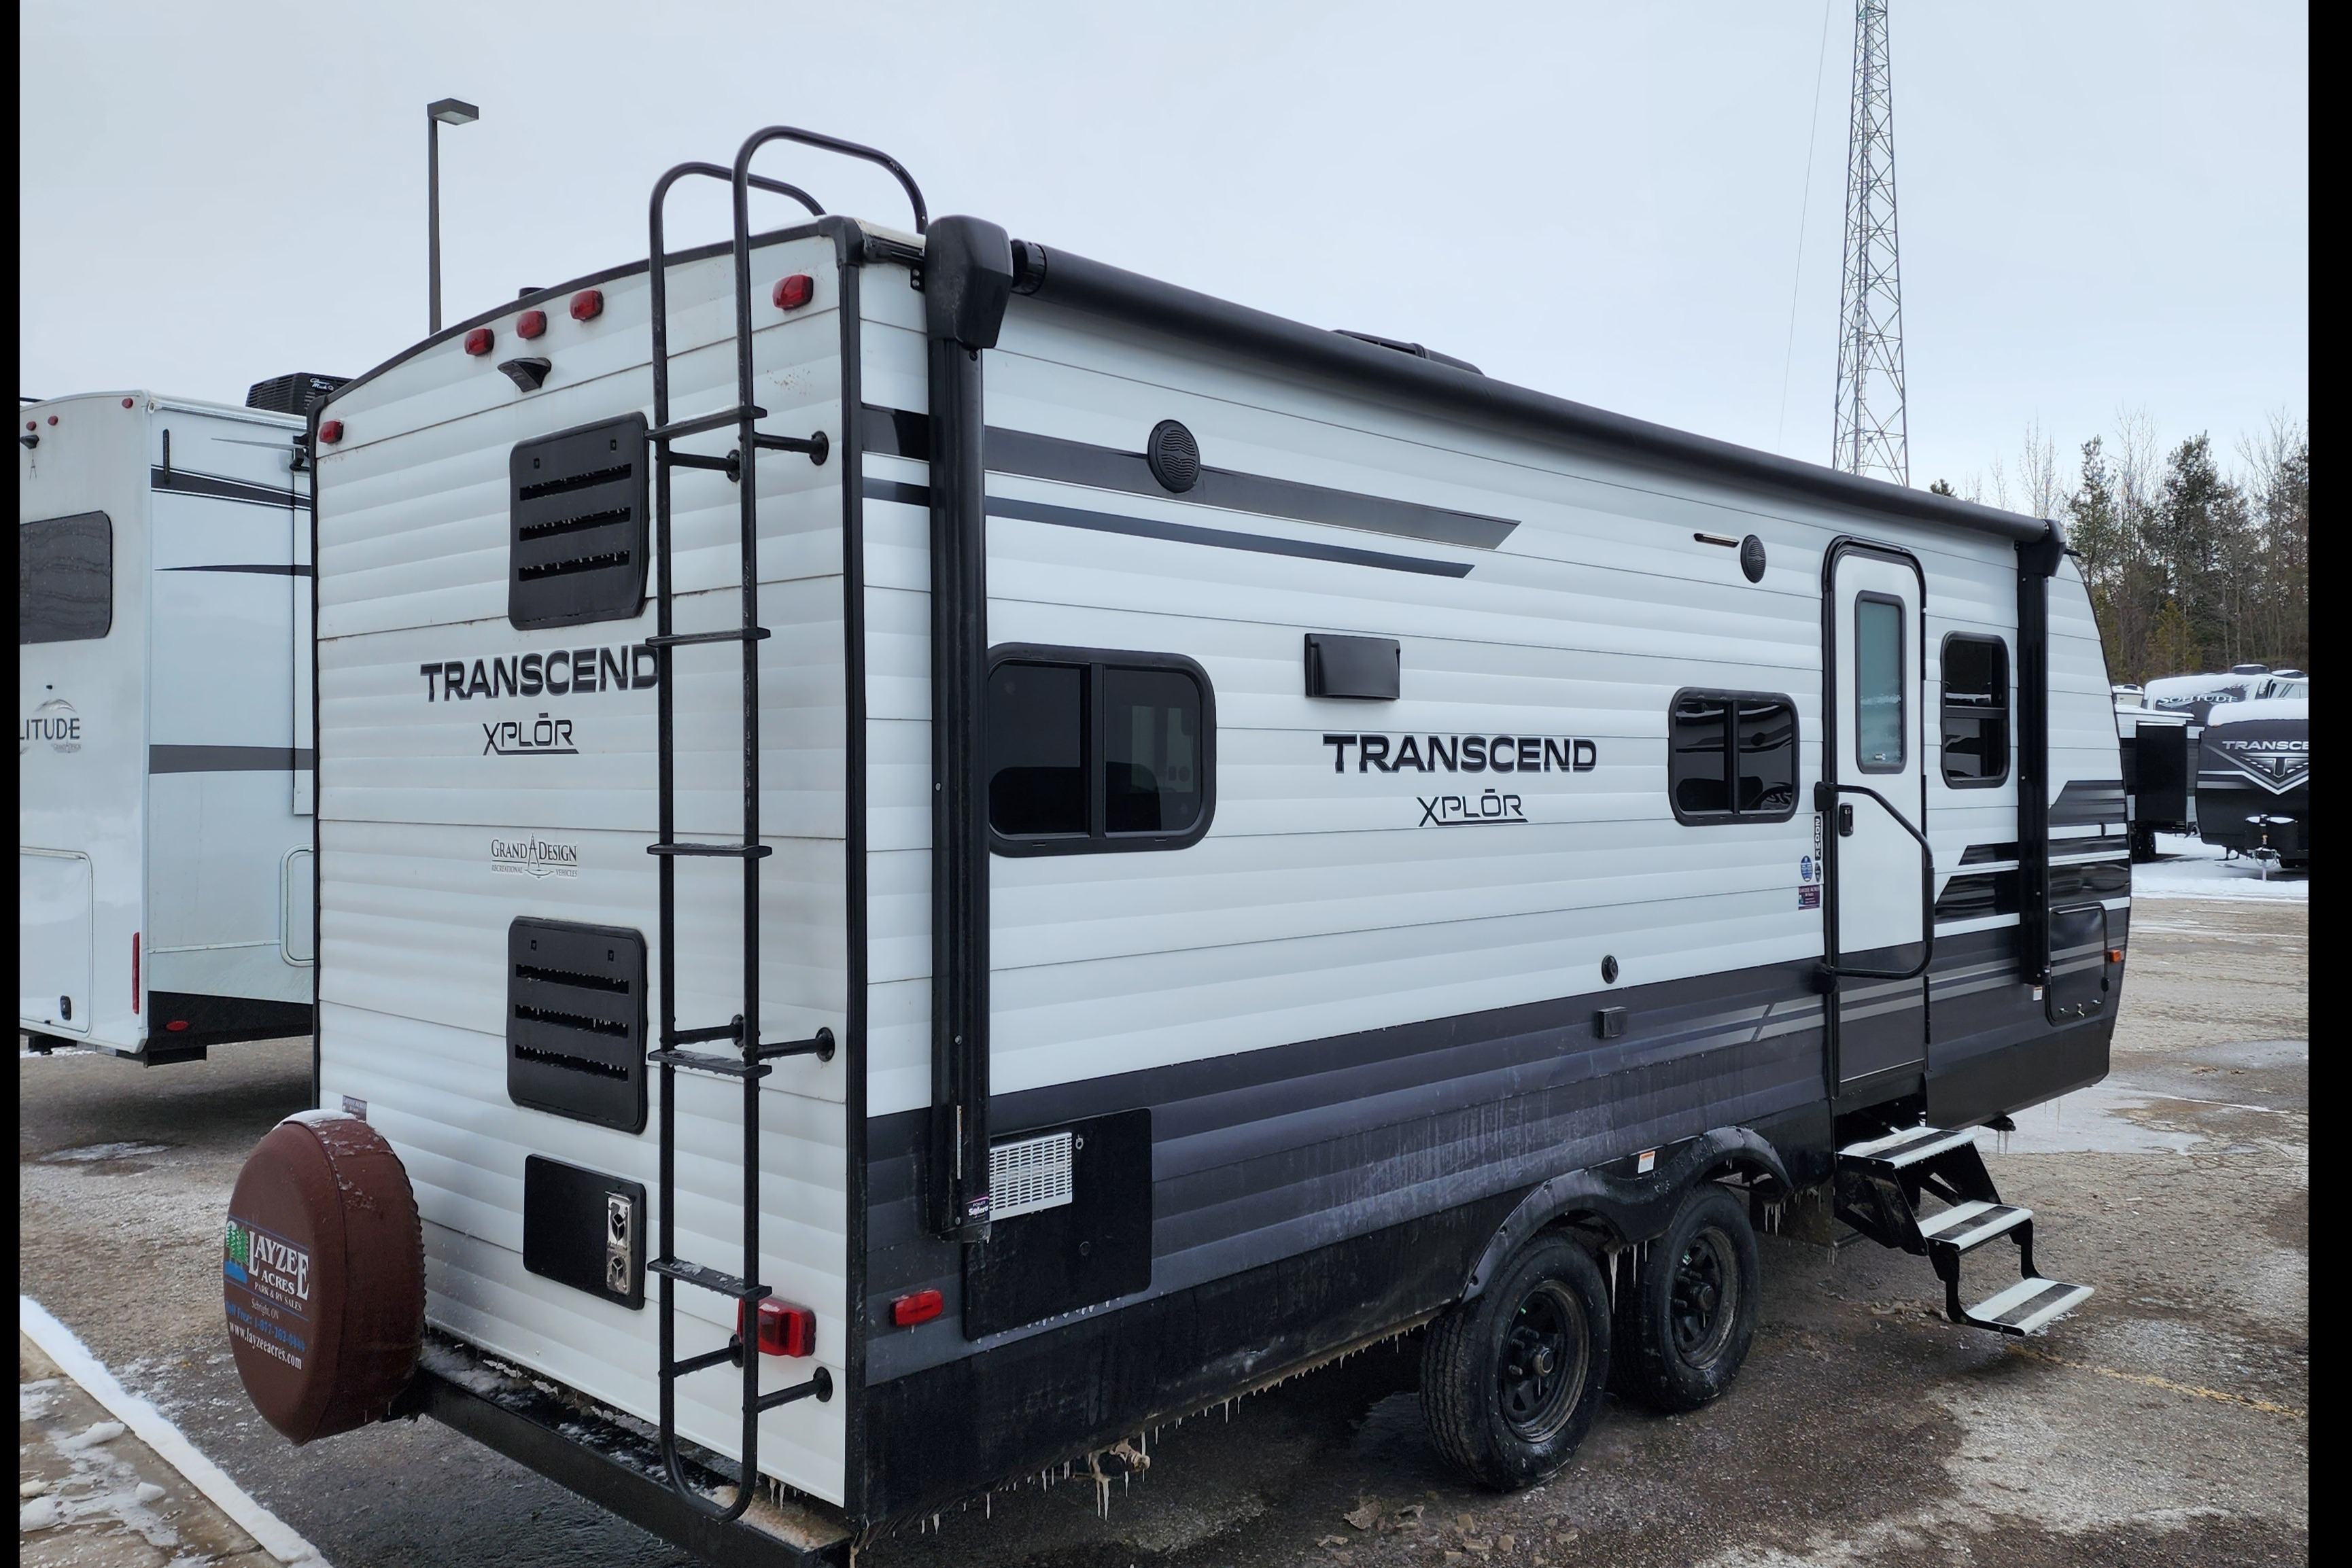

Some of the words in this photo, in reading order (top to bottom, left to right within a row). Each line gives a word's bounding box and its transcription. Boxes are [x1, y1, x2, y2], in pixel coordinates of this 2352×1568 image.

[420, 644, 658, 702] TRANSCEND
[20, 718, 80, 740] ITUDE
[1322, 733, 1597, 773] TRANSCEND
[491, 839, 528, 858] GRAND
[538, 841, 576, 862] DESIGN
[491, 865, 523, 873] RECREATIONAL
[555, 869, 577, 877] VEHICLES
[248, 1231, 309, 1301] LAYZEE
[254, 1281, 269, 1295] PARK
[275, 1291, 283, 1302] RV
[284, 1296, 302, 1312] SALES
[261, 1270, 295, 1295] ACRES
[229, 1321, 302, 1370] www.layzeeacres.com
